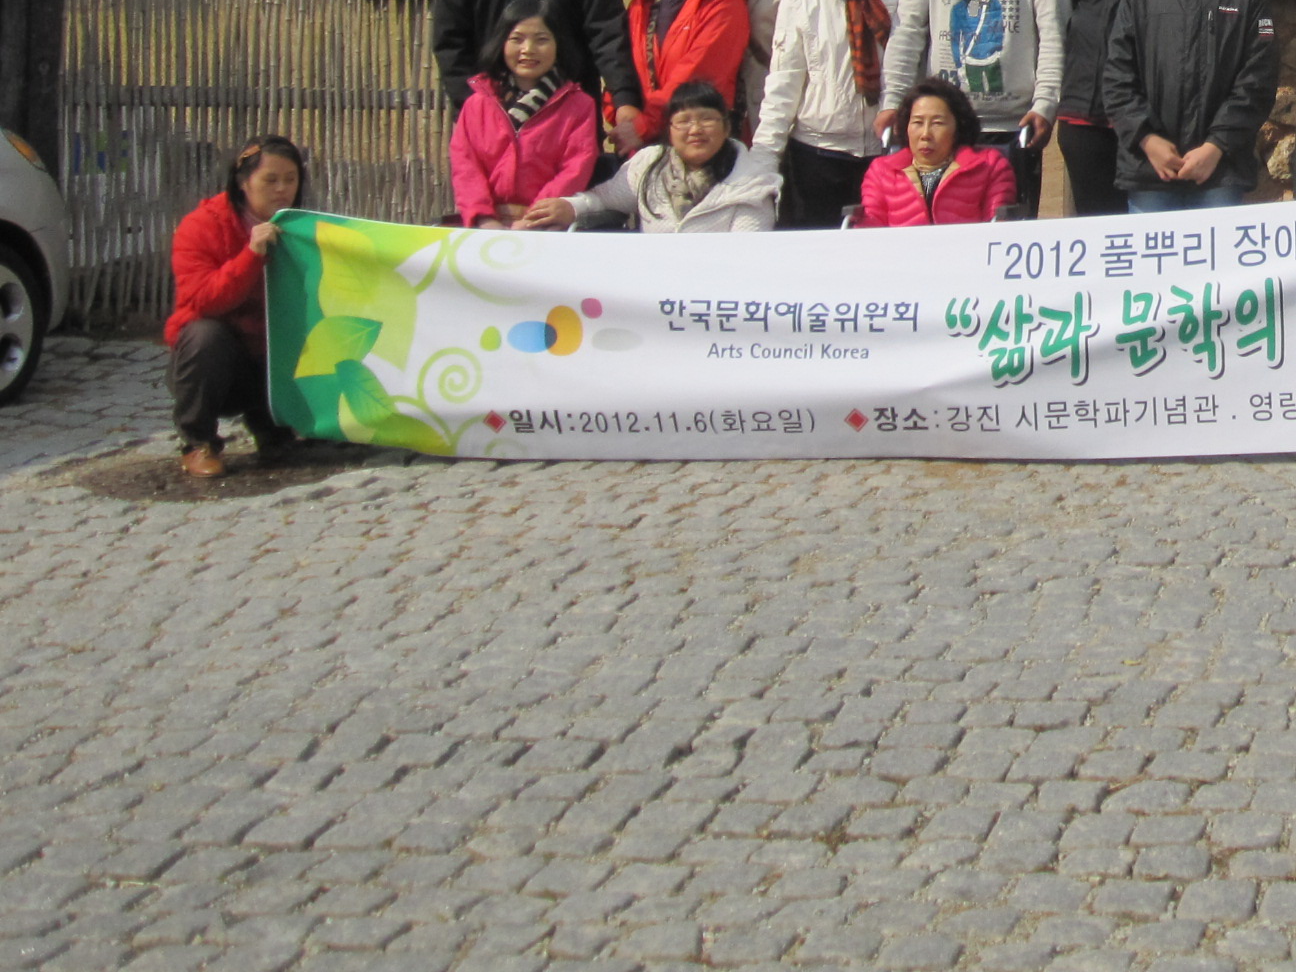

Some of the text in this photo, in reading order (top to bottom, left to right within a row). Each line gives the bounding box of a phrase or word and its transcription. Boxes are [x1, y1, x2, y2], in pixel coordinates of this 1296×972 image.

[1099, 225, 1216, 278] 풀뿌리
[658, 298, 920, 333] 한국문화예술위원회
[1114, 277, 1283, 379] 문학의
[707, 342, 870, 360] Arts Council Korea
[1015, 392, 1220, 431] 시문학파기념관
